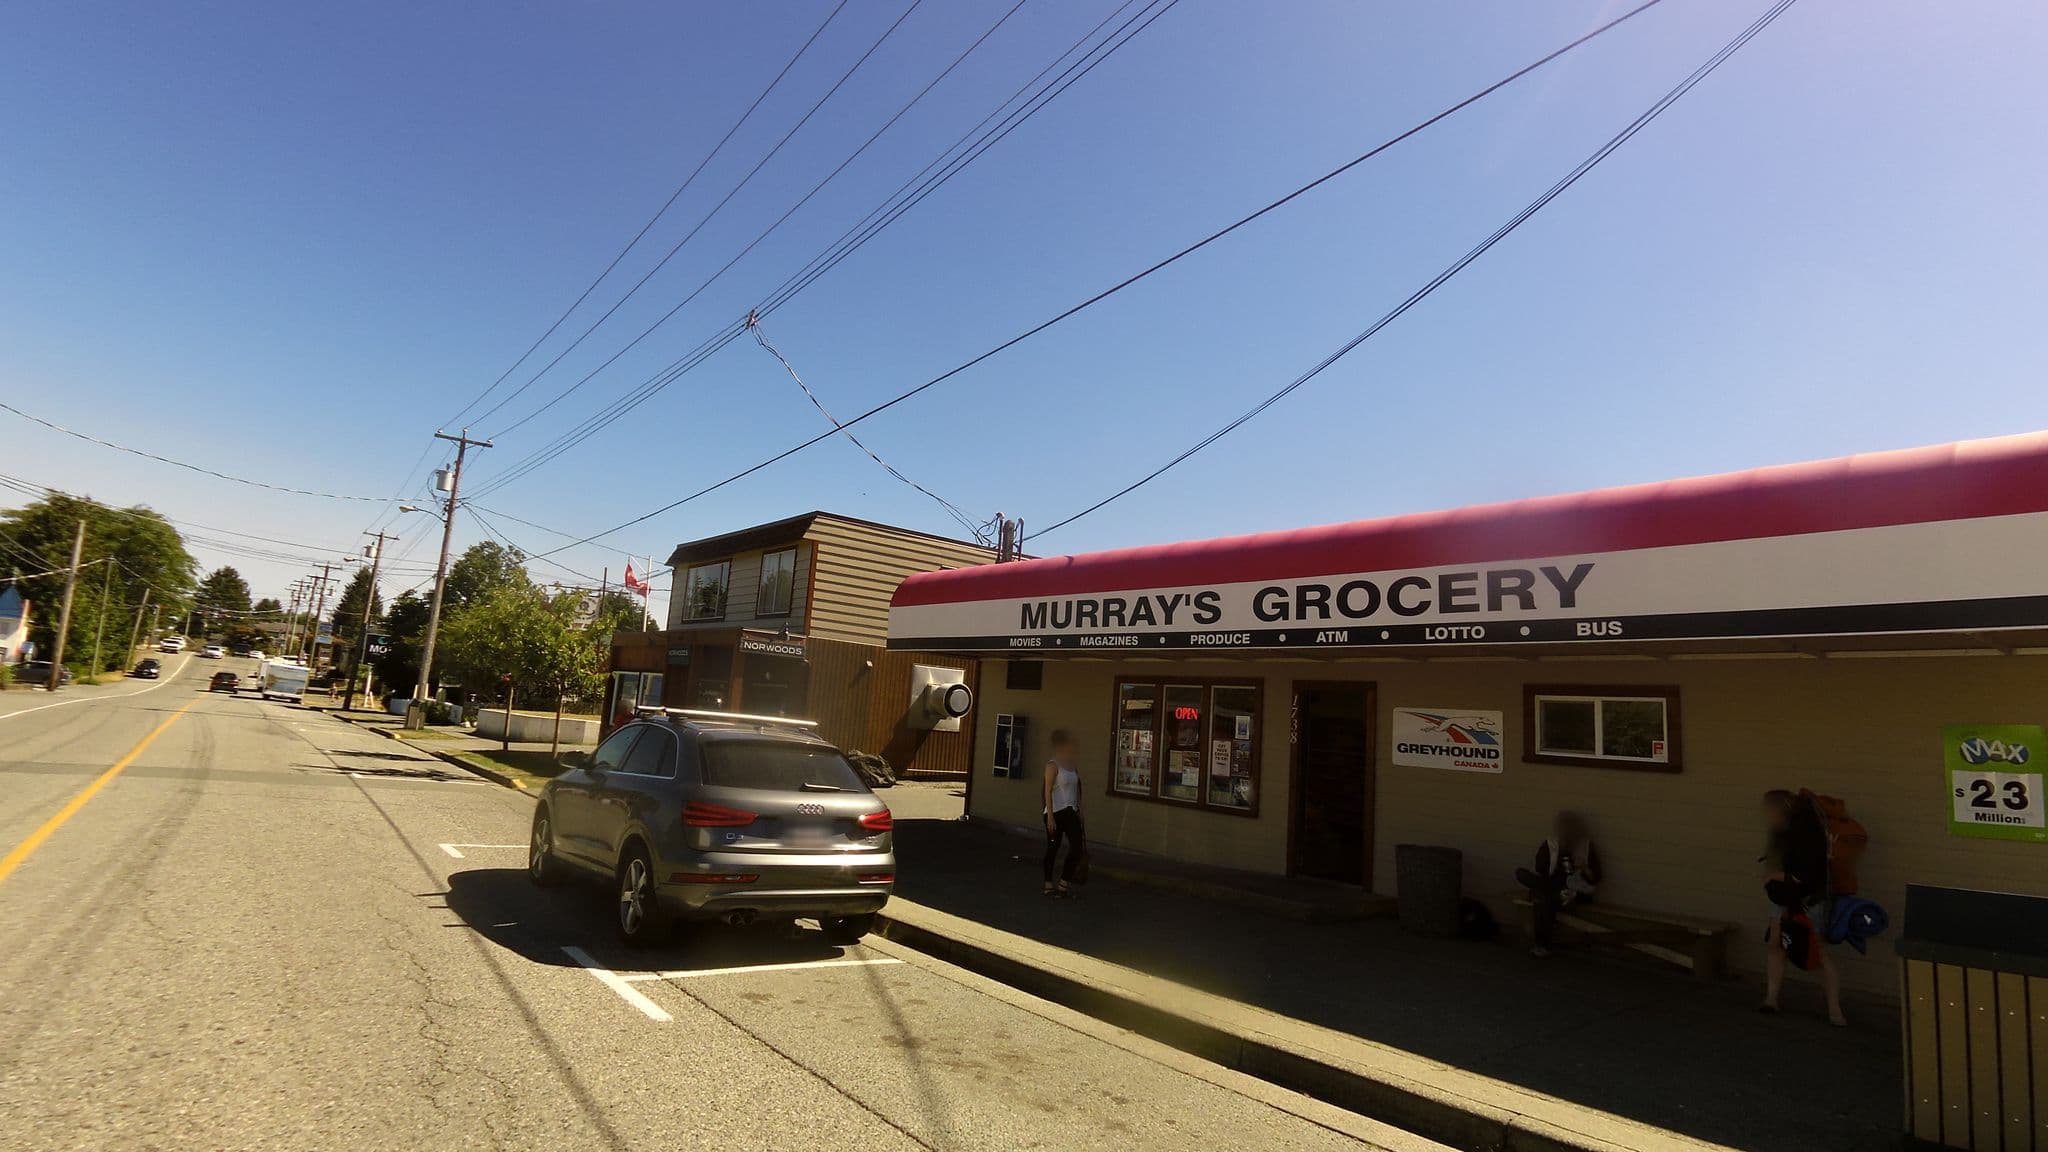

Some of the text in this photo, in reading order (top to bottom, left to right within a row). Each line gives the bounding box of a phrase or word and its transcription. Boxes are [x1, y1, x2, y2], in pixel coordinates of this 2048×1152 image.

[1020, 562, 1596, 630] MURRAY'S GROCERY
[1009, 620, 1624, 648] MOVIES MAGAZINES PRODUCE ATM LOTTO BUS
[743, 640, 803, 656] NORWOODS
[1175, 705, 1199, 720] OPEN
[1397, 742, 1500, 760] GREYHOUND
[1960, 738, 2027, 763] MAX
[1454, 759, 1491, 769] CANADA
